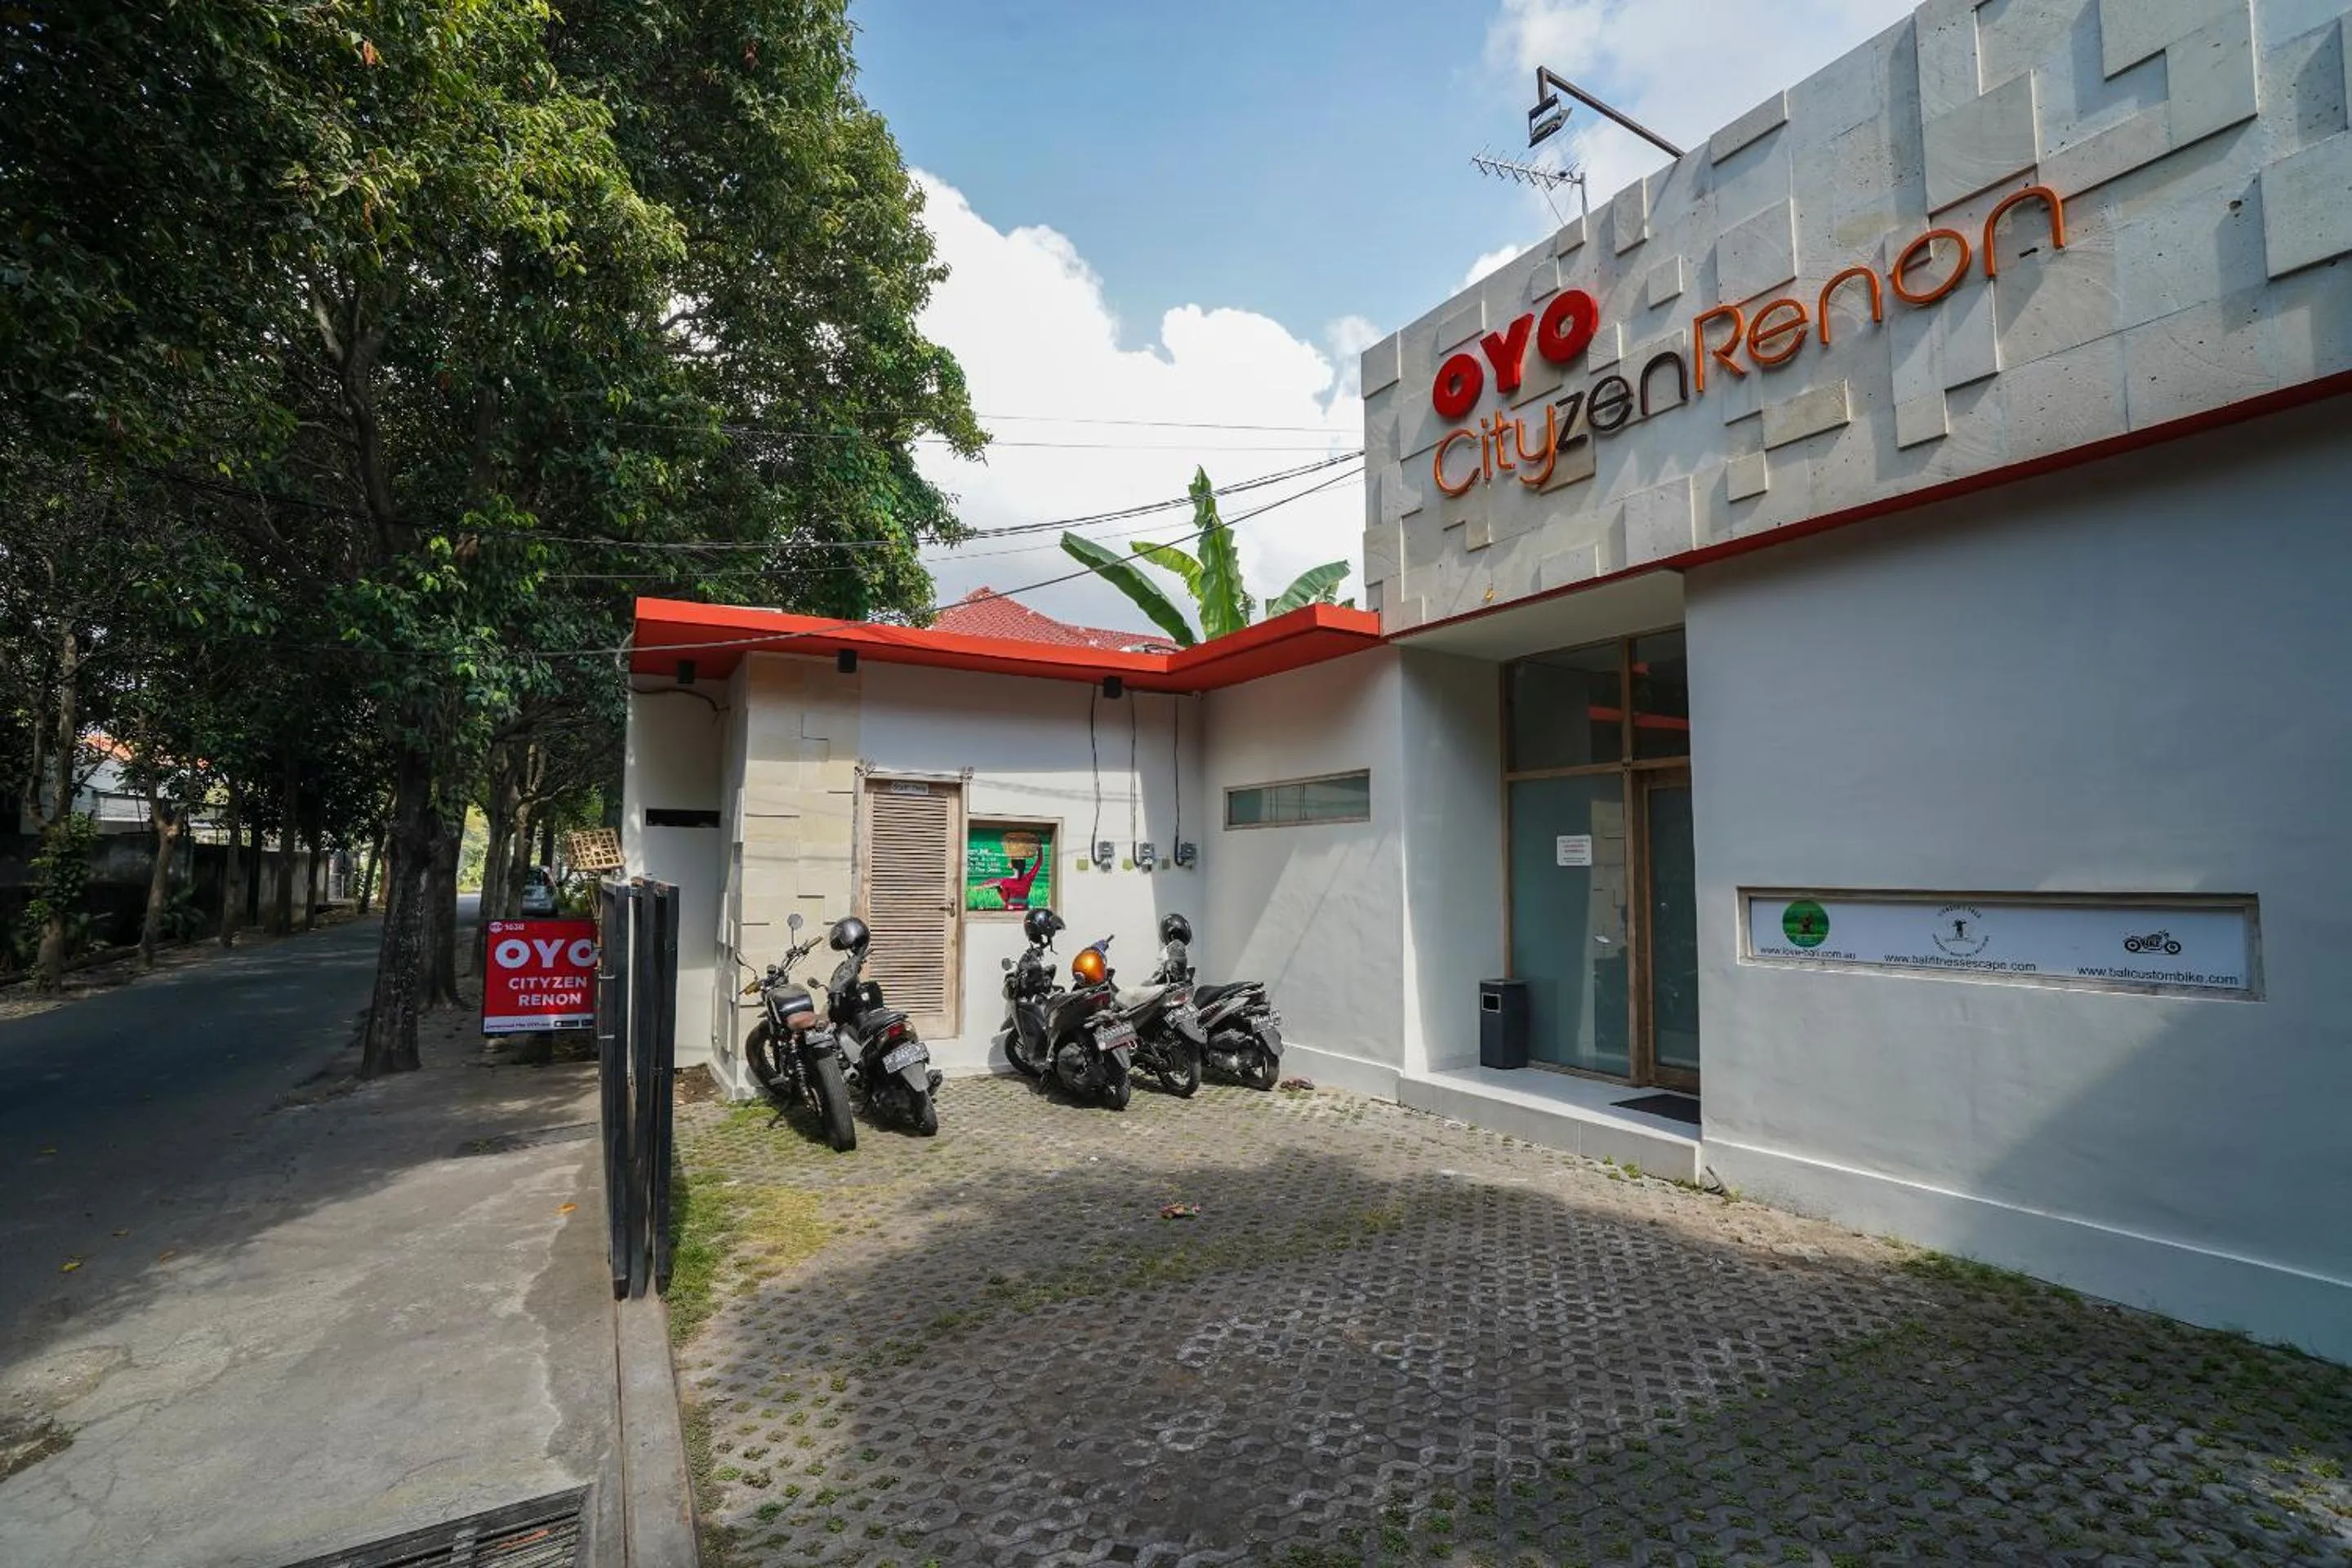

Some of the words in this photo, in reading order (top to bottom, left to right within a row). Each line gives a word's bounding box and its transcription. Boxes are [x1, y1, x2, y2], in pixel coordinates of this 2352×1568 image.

[1432, 289, 1599, 419] OYO
[495, 938, 600, 969] OYO
[509, 976, 587, 990] CITYZEN
[518, 992, 581, 1006] RENON
